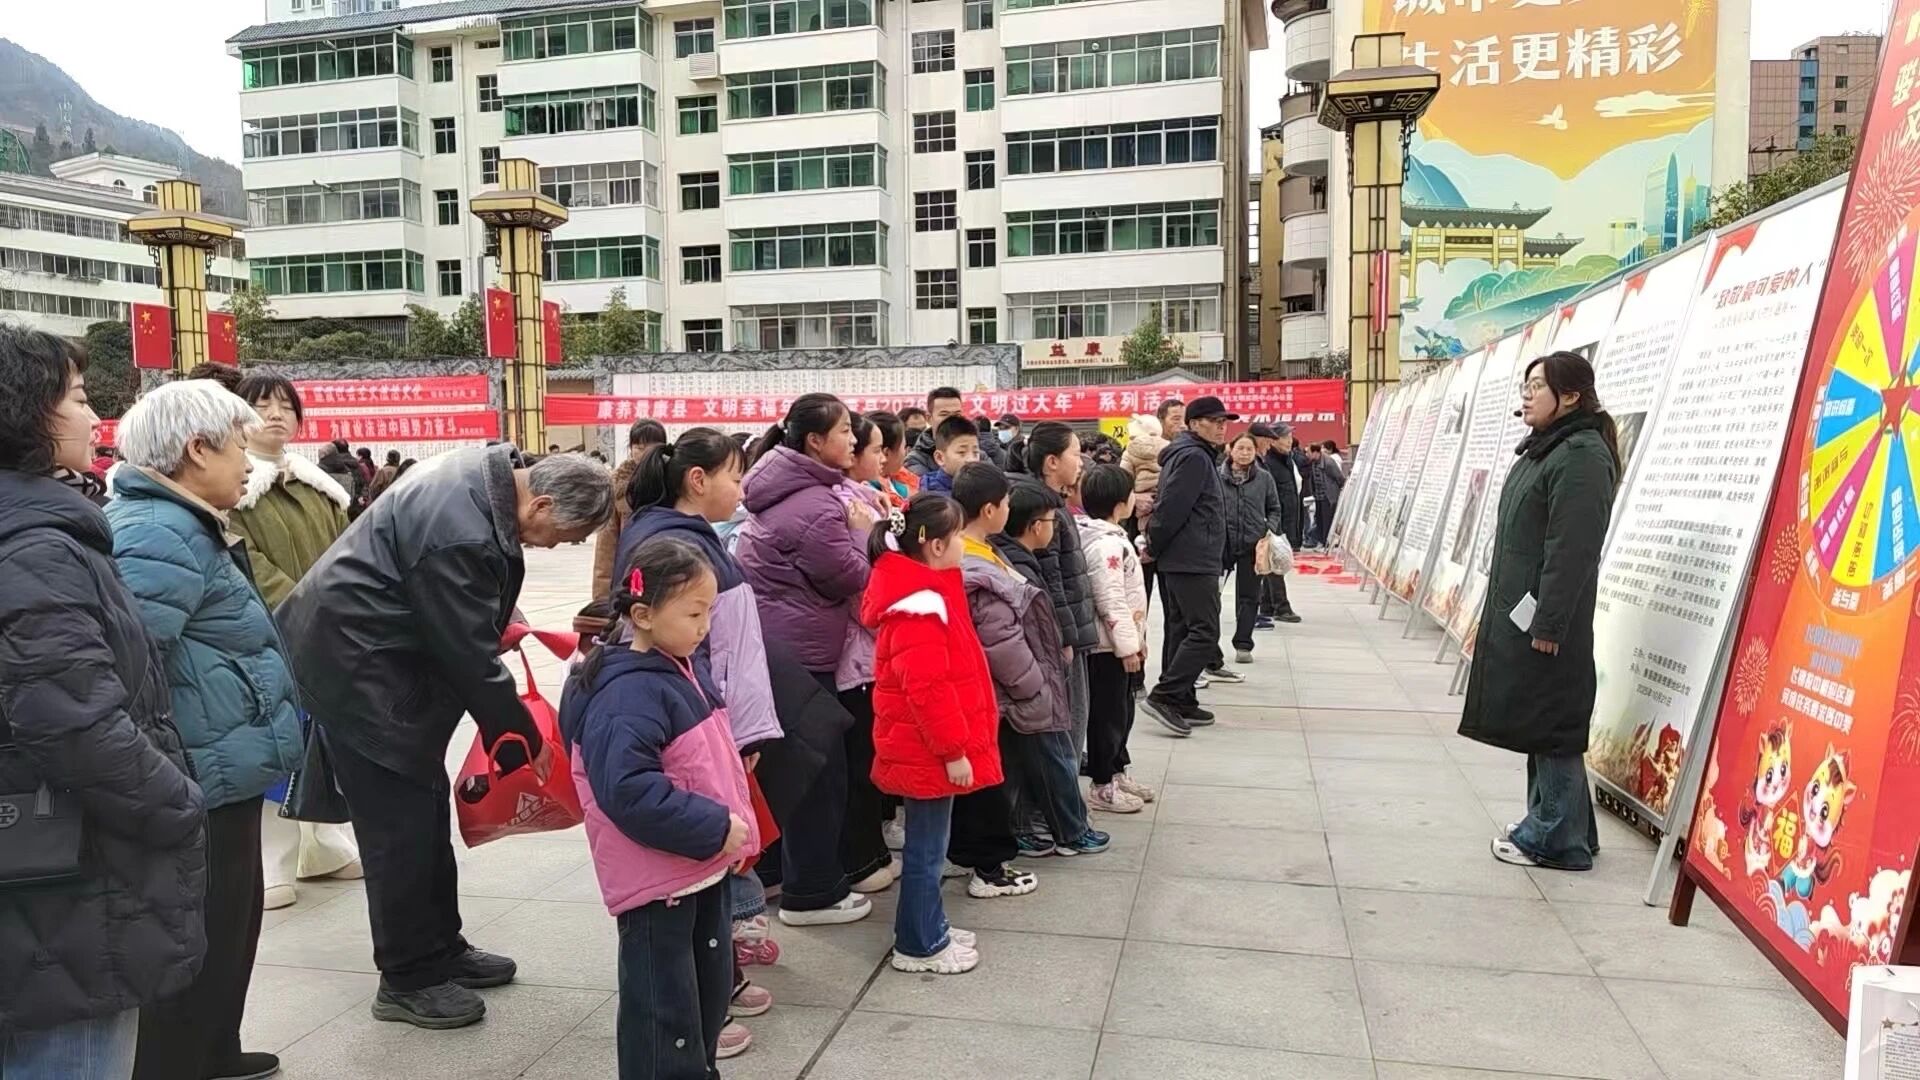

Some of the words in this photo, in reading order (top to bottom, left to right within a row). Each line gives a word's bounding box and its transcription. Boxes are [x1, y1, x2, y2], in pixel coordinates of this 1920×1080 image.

[1402, 23, 1684, 87] 生活更精彩
[597, 399, 688, 420] 康养最康县
[1772, 807, 1799, 860] 福
